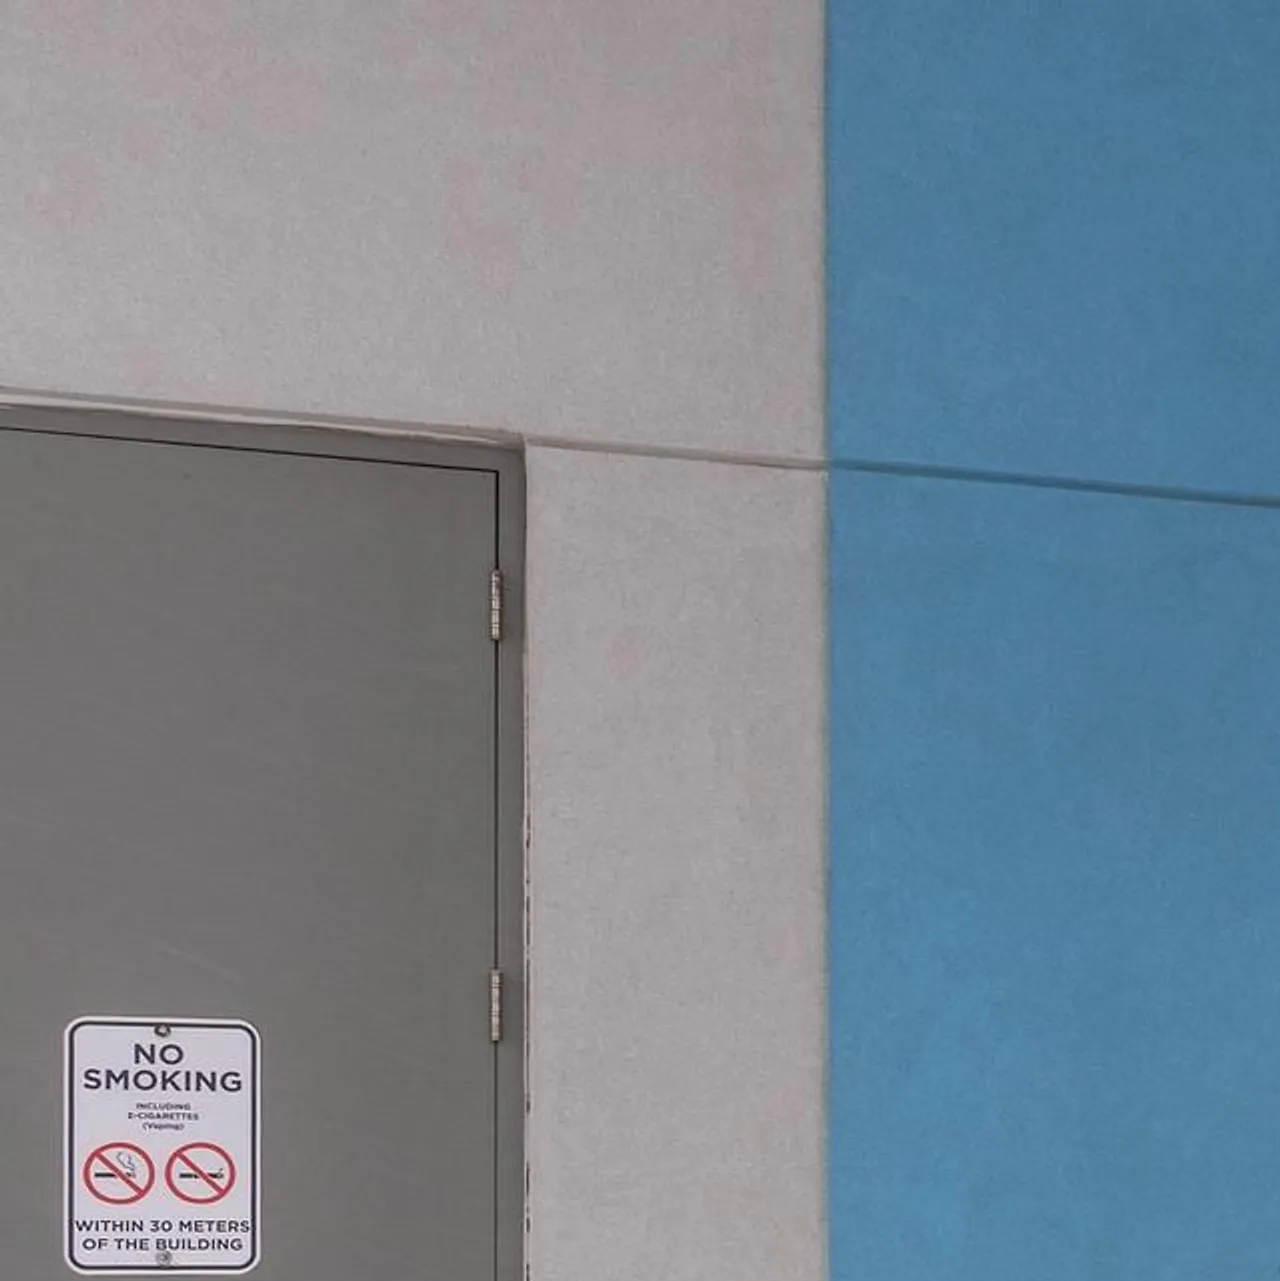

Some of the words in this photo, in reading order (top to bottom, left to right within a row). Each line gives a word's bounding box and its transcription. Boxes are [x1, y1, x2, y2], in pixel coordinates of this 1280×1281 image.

[133, 1043, 184, 1065] NO
[83, 1068, 243, 1092] SMOKING
[136, 1102, 191, 1112] INCLUDING
[75, 1219, 144, 1233] WITHIN
[150, 1220, 173, 1233] 30
[179, 1220, 250, 1233] METERS
[82, 1238, 108, 1250] OF
[114, 1238, 150, 1250] THE
[156, 1238, 243, 1251] BUILDING
